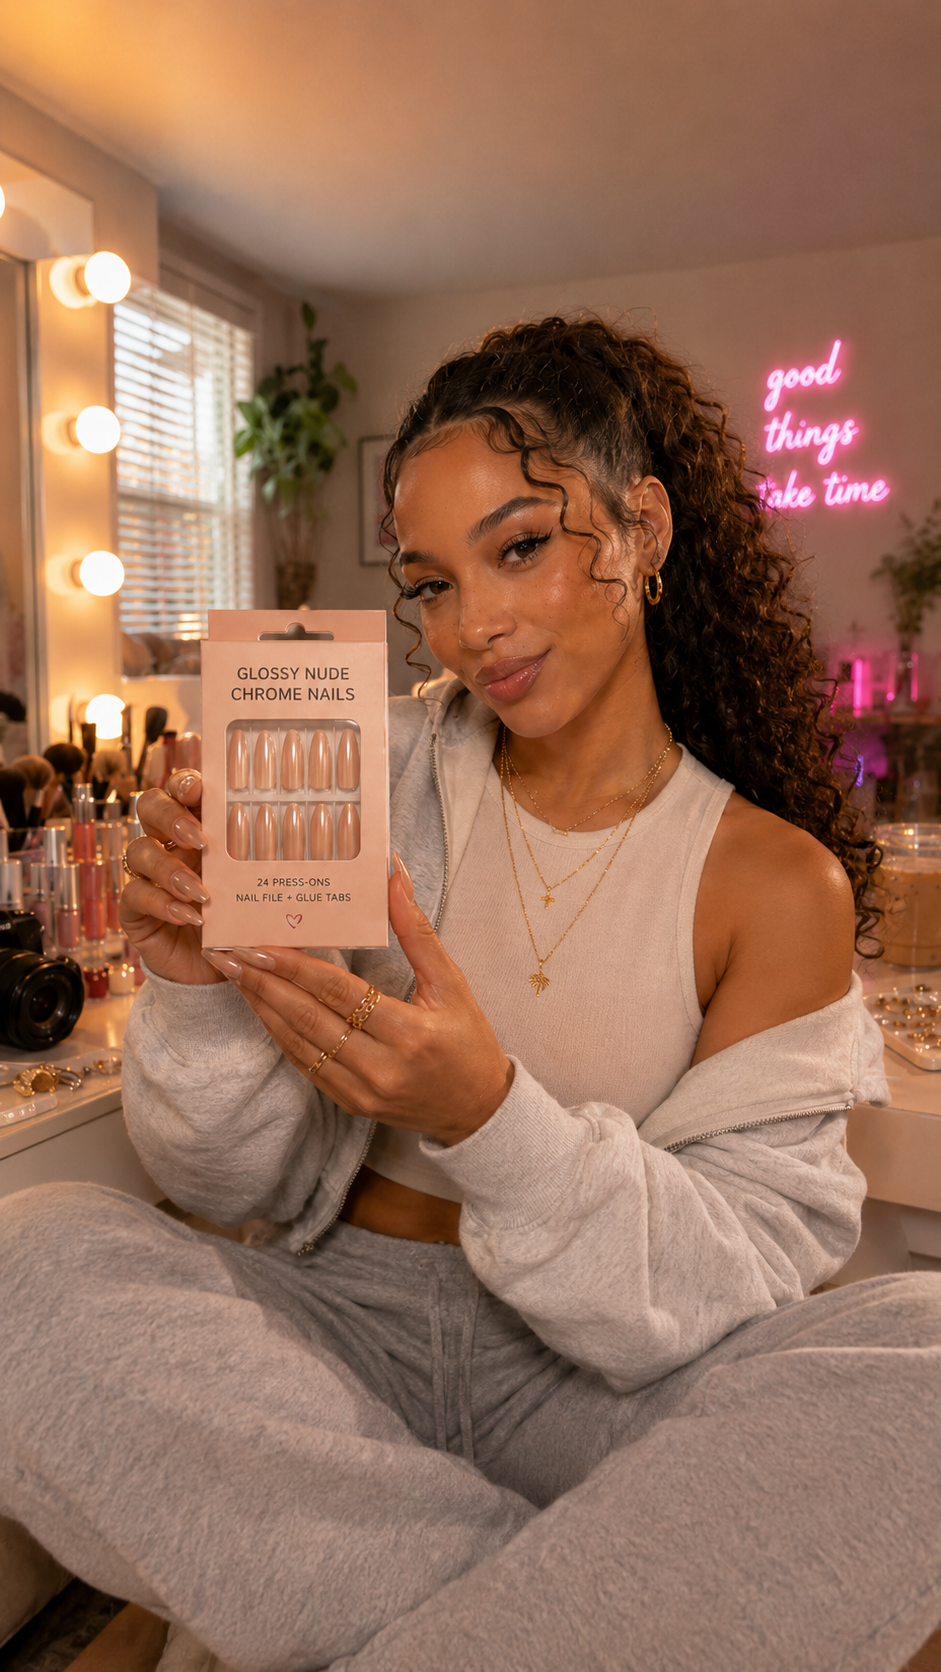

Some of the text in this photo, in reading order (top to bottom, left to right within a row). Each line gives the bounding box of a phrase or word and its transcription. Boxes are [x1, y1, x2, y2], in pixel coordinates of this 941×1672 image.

[764, 339, 842, 412] good
[764, 411, 860, 466] things
[823, 471, 891, 507] time
[237, 666, 350, 681] GLOSSY NUDE
[231, 687, 356, 701] CHROME NAILS
[256, 877, 331, 887] 24 PRESS-ONS
[235, 892, 260, 902] NAIL
[262, 892, 283, 902] FILE
[295, 892, 322, 902] GLUE
[325, 892, 352, 902] TABS
